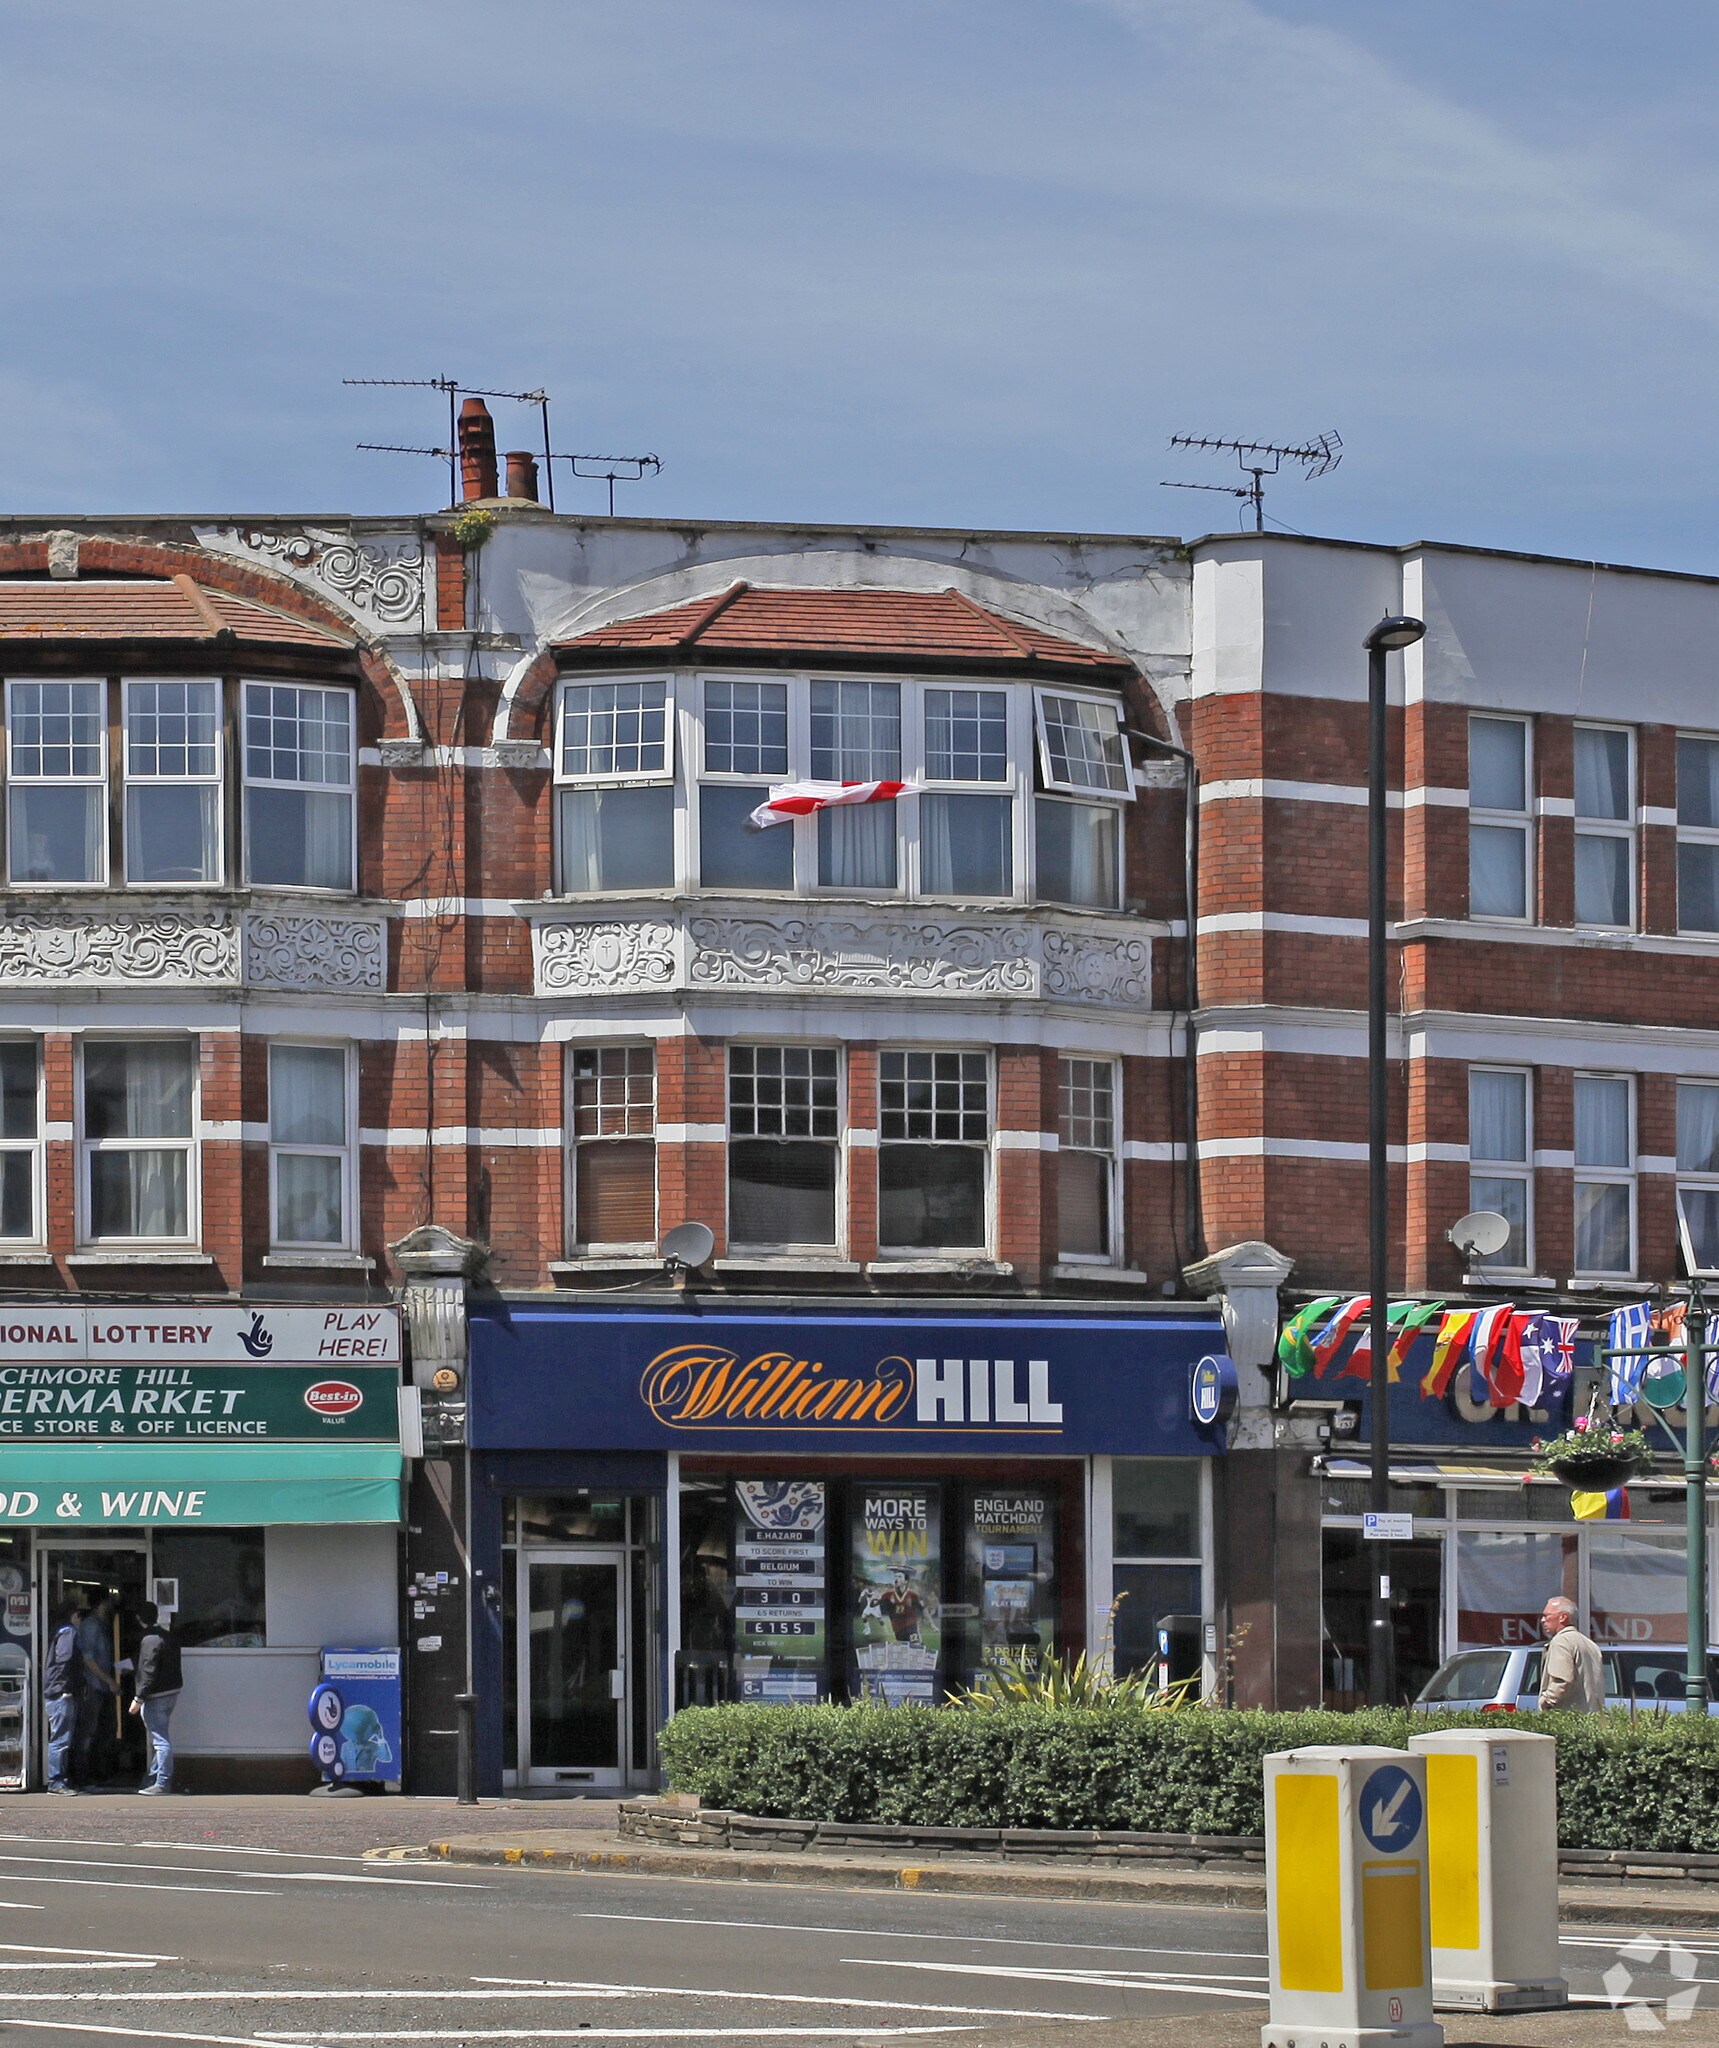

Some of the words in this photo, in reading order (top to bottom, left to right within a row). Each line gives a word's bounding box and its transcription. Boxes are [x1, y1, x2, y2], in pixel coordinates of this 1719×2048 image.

[323, 1312, 381, 1331] PLAY
[0, 1325, 78, 1343] IONAL
[93, 1325, 213, 1343] LOTTERY
[318, 1338, 388, 1357] HERE!
[0, 1368, 122, 1385] CHMORE
[136, 1368, 194, 1385] HILL
[640, 1344, 914, 1422] William
[916, 1359, 1063, 1422] HILL
[0, 1389, 245, 1414] ERMARKET
[309, 1391, 358, 1401] Best-in
[34, 1420, 99, 1433] STORE
[110, 1420, 125, 1433] &
[137, 1420, 175, 1434] OFF
[186, 1420, 267, 1434] LICENCE
[321, 1416, 346, 1424] VALUE
[0, 1491, 39, 1517] D
[56, 1492, 83, 1517] &
[101, 1491, 207, 1517] WINE
[865, 1499, 927, 1517] MORE
[974, 1499, 1044, 1512] ENGLAND
[865, 1518, 905, 1530] WAYS
[909, 1518, 927, 1530] TO
[974, 1513, 1043, 1524] MATCHDAY
[975, 1524, 1044, 1534] TOURNAMENT
[756, 1532, 803, 1541] E.HAZARD
[866, 1530, 928, 1557] WIN
[760, 1562, 800, 1571] BELGIUM
[760, 1592, 769, 1603] 3
[792, 1592, 801, 1603] 0
[1502, 1618, 1654, 1641] ENAND
[328, 1659, 397, 1671] Lycamobile
